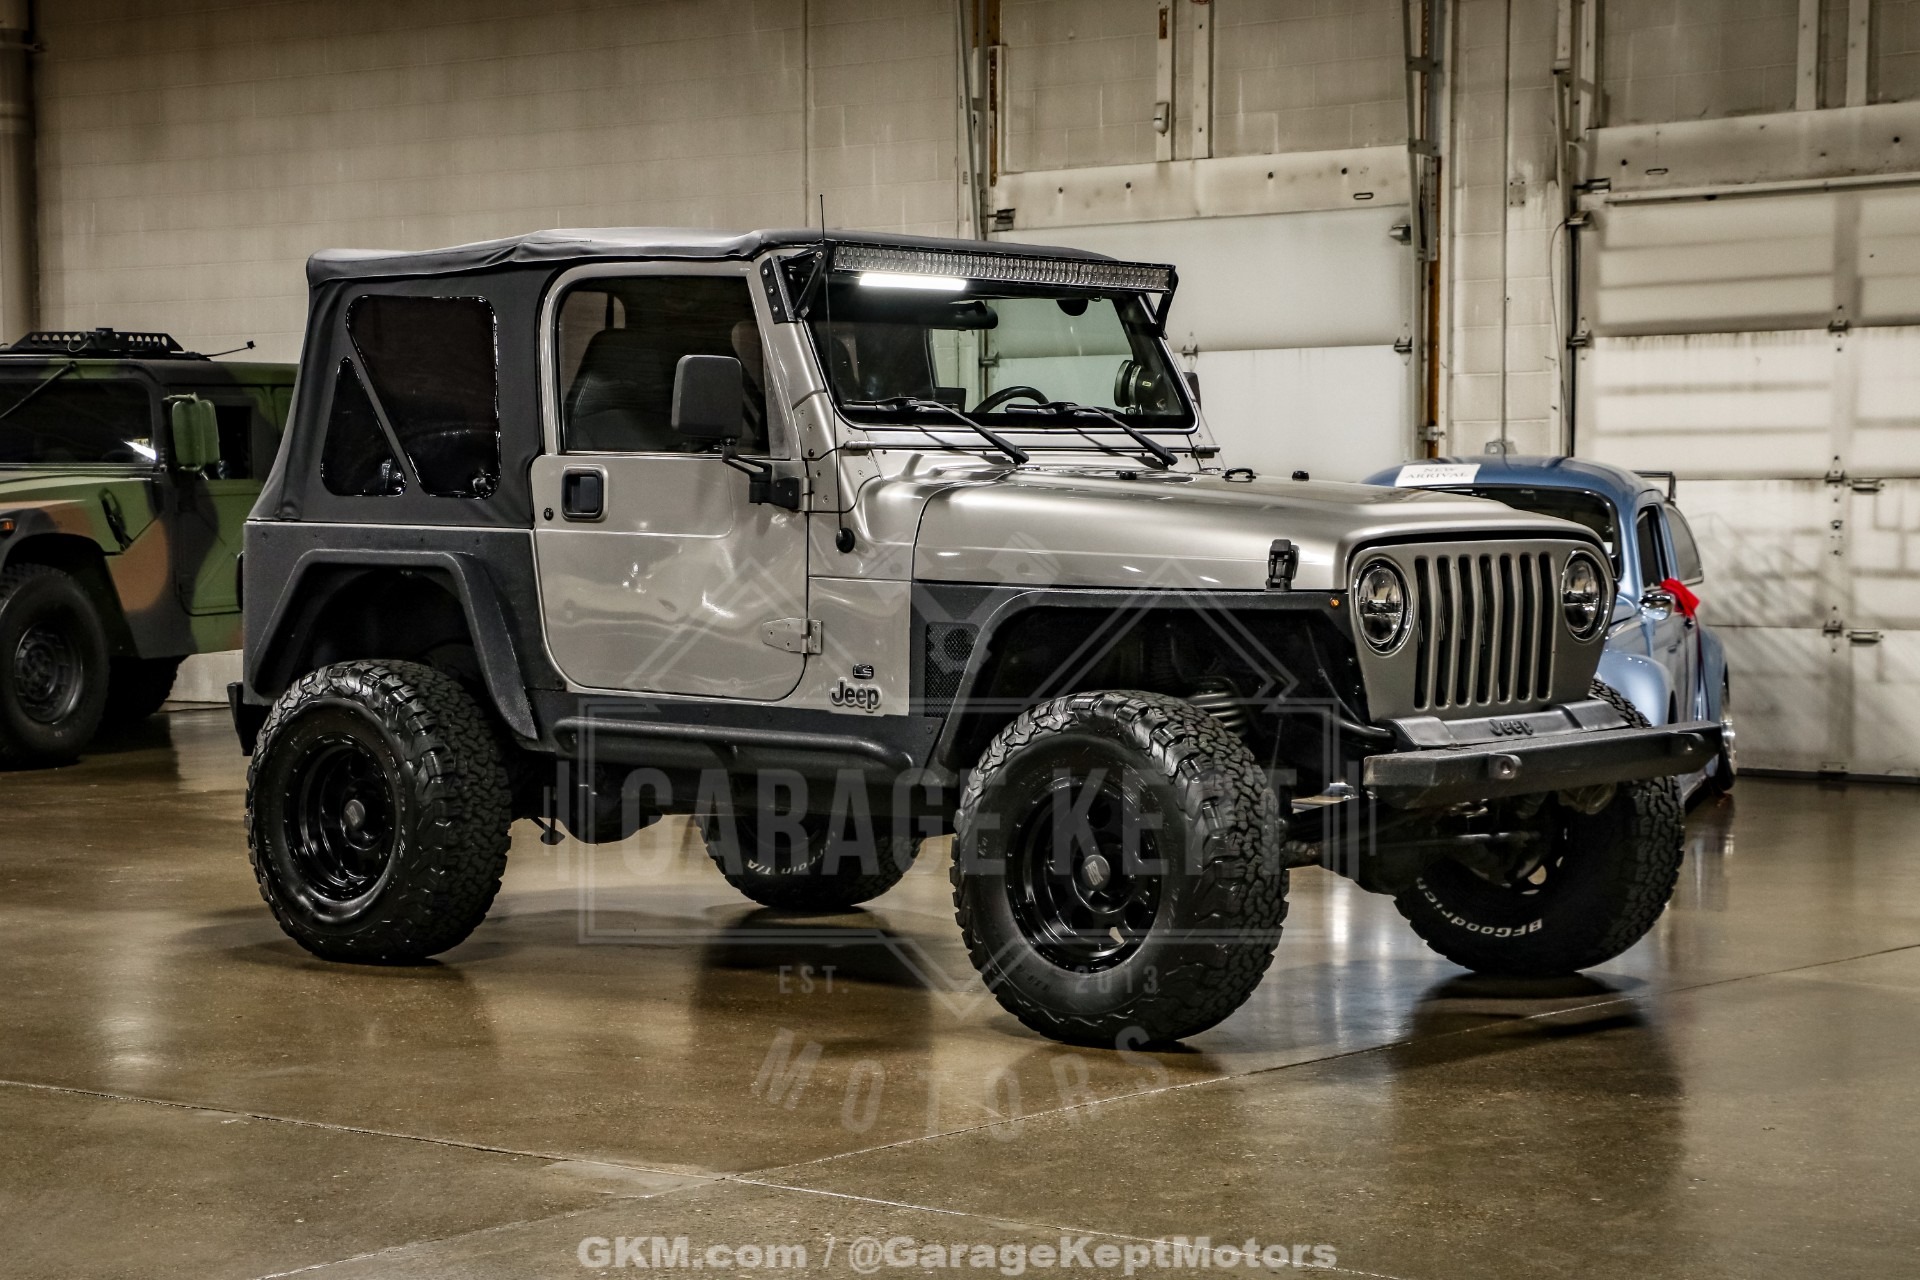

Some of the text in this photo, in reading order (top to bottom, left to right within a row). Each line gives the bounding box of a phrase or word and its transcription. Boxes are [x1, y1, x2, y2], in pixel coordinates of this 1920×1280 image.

[830, 678, 881, 711] Jeep
[1489, 719, 1533, 736] Jeep
[747, 859, 772, 876] T/A
[1416, 877, 1543, 938] BFGoodrich
